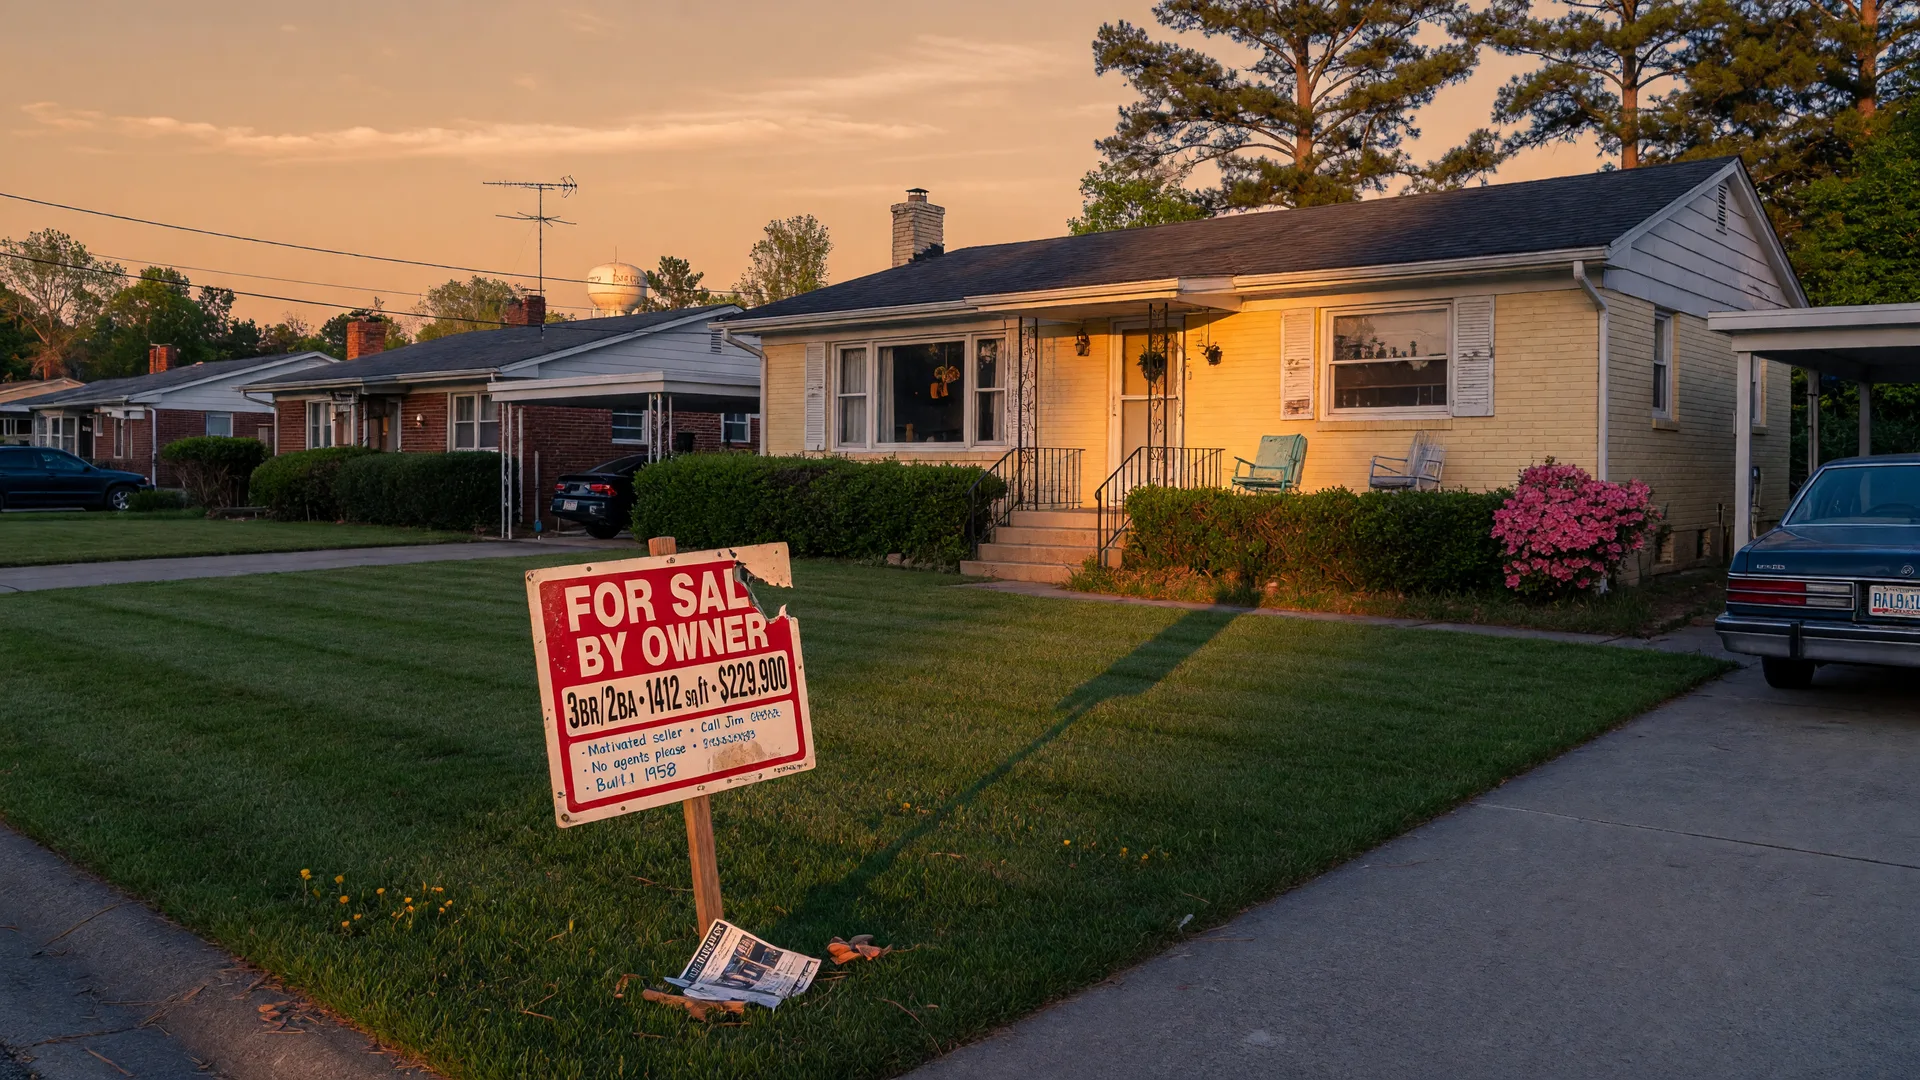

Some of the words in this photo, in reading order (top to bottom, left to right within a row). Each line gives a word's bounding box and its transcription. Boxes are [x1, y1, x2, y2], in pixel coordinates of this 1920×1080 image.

[565, 578, 656, 632] FOR
[670, 568, 750, 618] SAL
[576, 631, 627, 678] BY
[641, 612, 769, 667] OWNER
[567, 685, 638, 729] 3BR/2BA
[646, 674, 683, 715] 1412
[718, 655, 788, 704] $229,900
[588, 733, 647, 757] Motivated
[652, 728, 683, 743] seller
[701, 719, 721, 733] Call
[725, 715, 744, 729] Jim
[591, 761, 607, 773] No
[613, 752, 650, 770] agents
[655, 745, 686, 763] please
[645, 762, 677, 782] 1958
